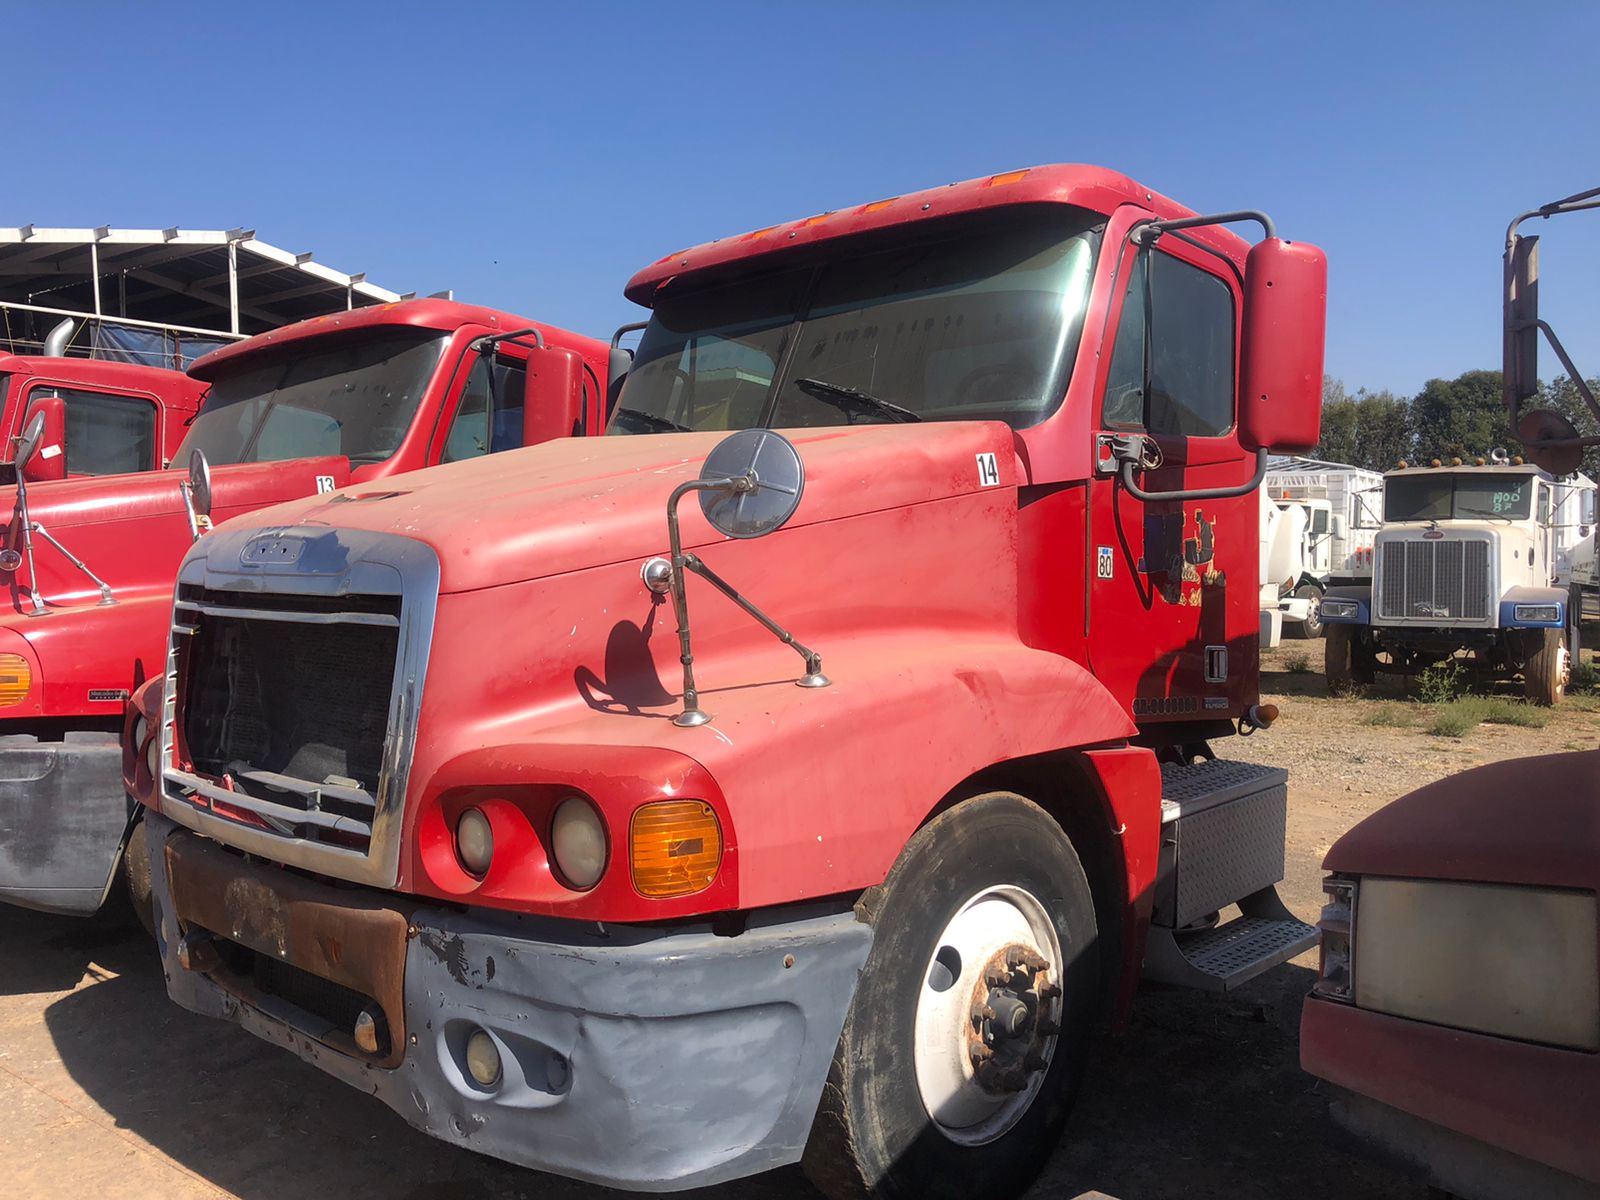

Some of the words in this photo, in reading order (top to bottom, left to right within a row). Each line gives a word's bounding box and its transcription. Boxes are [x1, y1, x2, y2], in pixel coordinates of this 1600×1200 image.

[978, 454, 998, 485] 14
[318, 477, 334, 493] 13
[1099, 555, 1112, 577] 80
